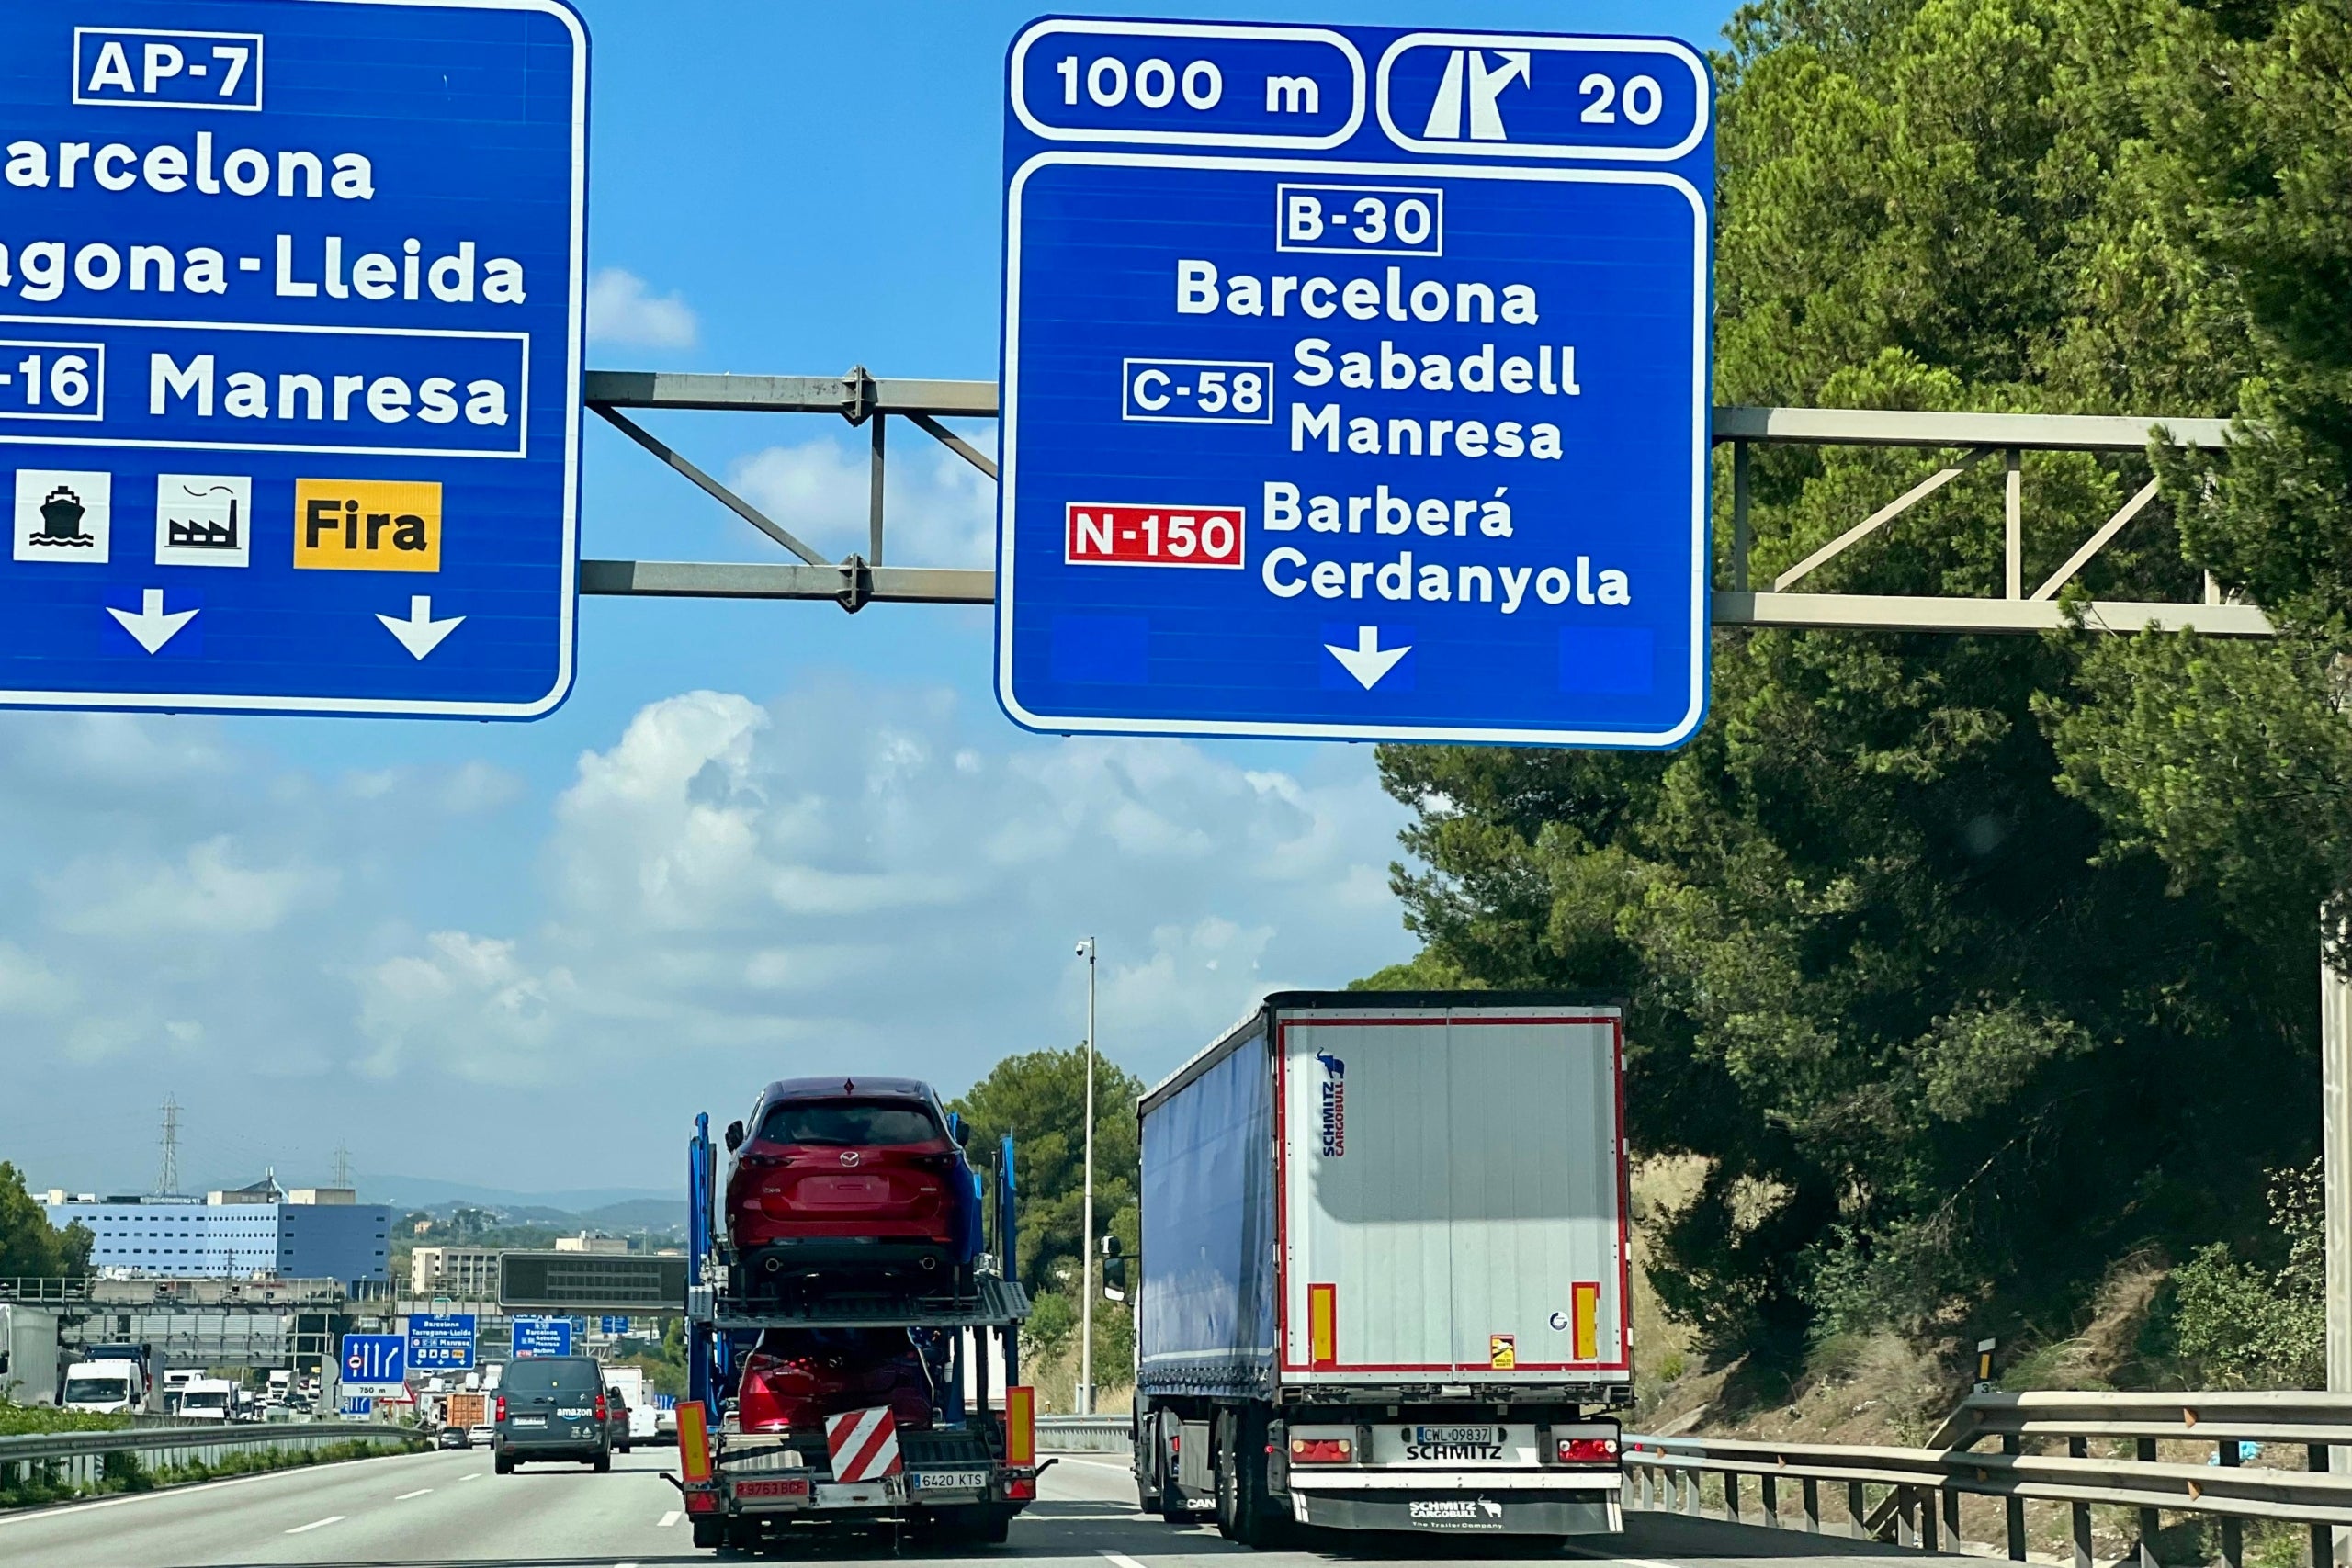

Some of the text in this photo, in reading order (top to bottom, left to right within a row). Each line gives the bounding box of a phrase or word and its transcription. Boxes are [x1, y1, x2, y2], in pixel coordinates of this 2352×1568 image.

[88, 41, 250, 96] AP-7
[1057, 57, 1319, 114] 1000 m
[1578, 73, 1663, 126] 20
[5, 131, 375, 200] arcelona
[1288, 196, 1431, 244] B-30
[0, 235, 526, 305] gona-Lleida
[1177, 259, 1539, 325] Barcelona
[0, 353, 509, 426] -16 Manresa
[1133, 369, 1262, 413] C-58
[1292, 338, 1581, 396] Sabadell
[1291, 402, 1564, 460] Manresa
[305, 499, 428, 552] Fira
[1074, 513, 1236, 558] N-150
[1263, 481, 1514, 538] Barberá
[1261, 547, 1632, 615] Cerdanyola
[1322, 1081, 1335, 1157] SCHMITZ
[1335, 1081, 1345, 1157] CARGOBULL
[556, 1408, 593, 1417] amazon
[1424, 1428, 1488, 1441] CWL 09837
[1406, 1445, 1503, 1461] SCHMITZ
[747, 1483, 778, 1495] 9763
[922, 1473, 982, 1487] 6420 KTS
[1176, 1498, 1216, 1508] SCAN
[1409, 1500, 1476, 1511] SCHMITZ
[1410, 1510, 1477, 1518] CARGOBULL
